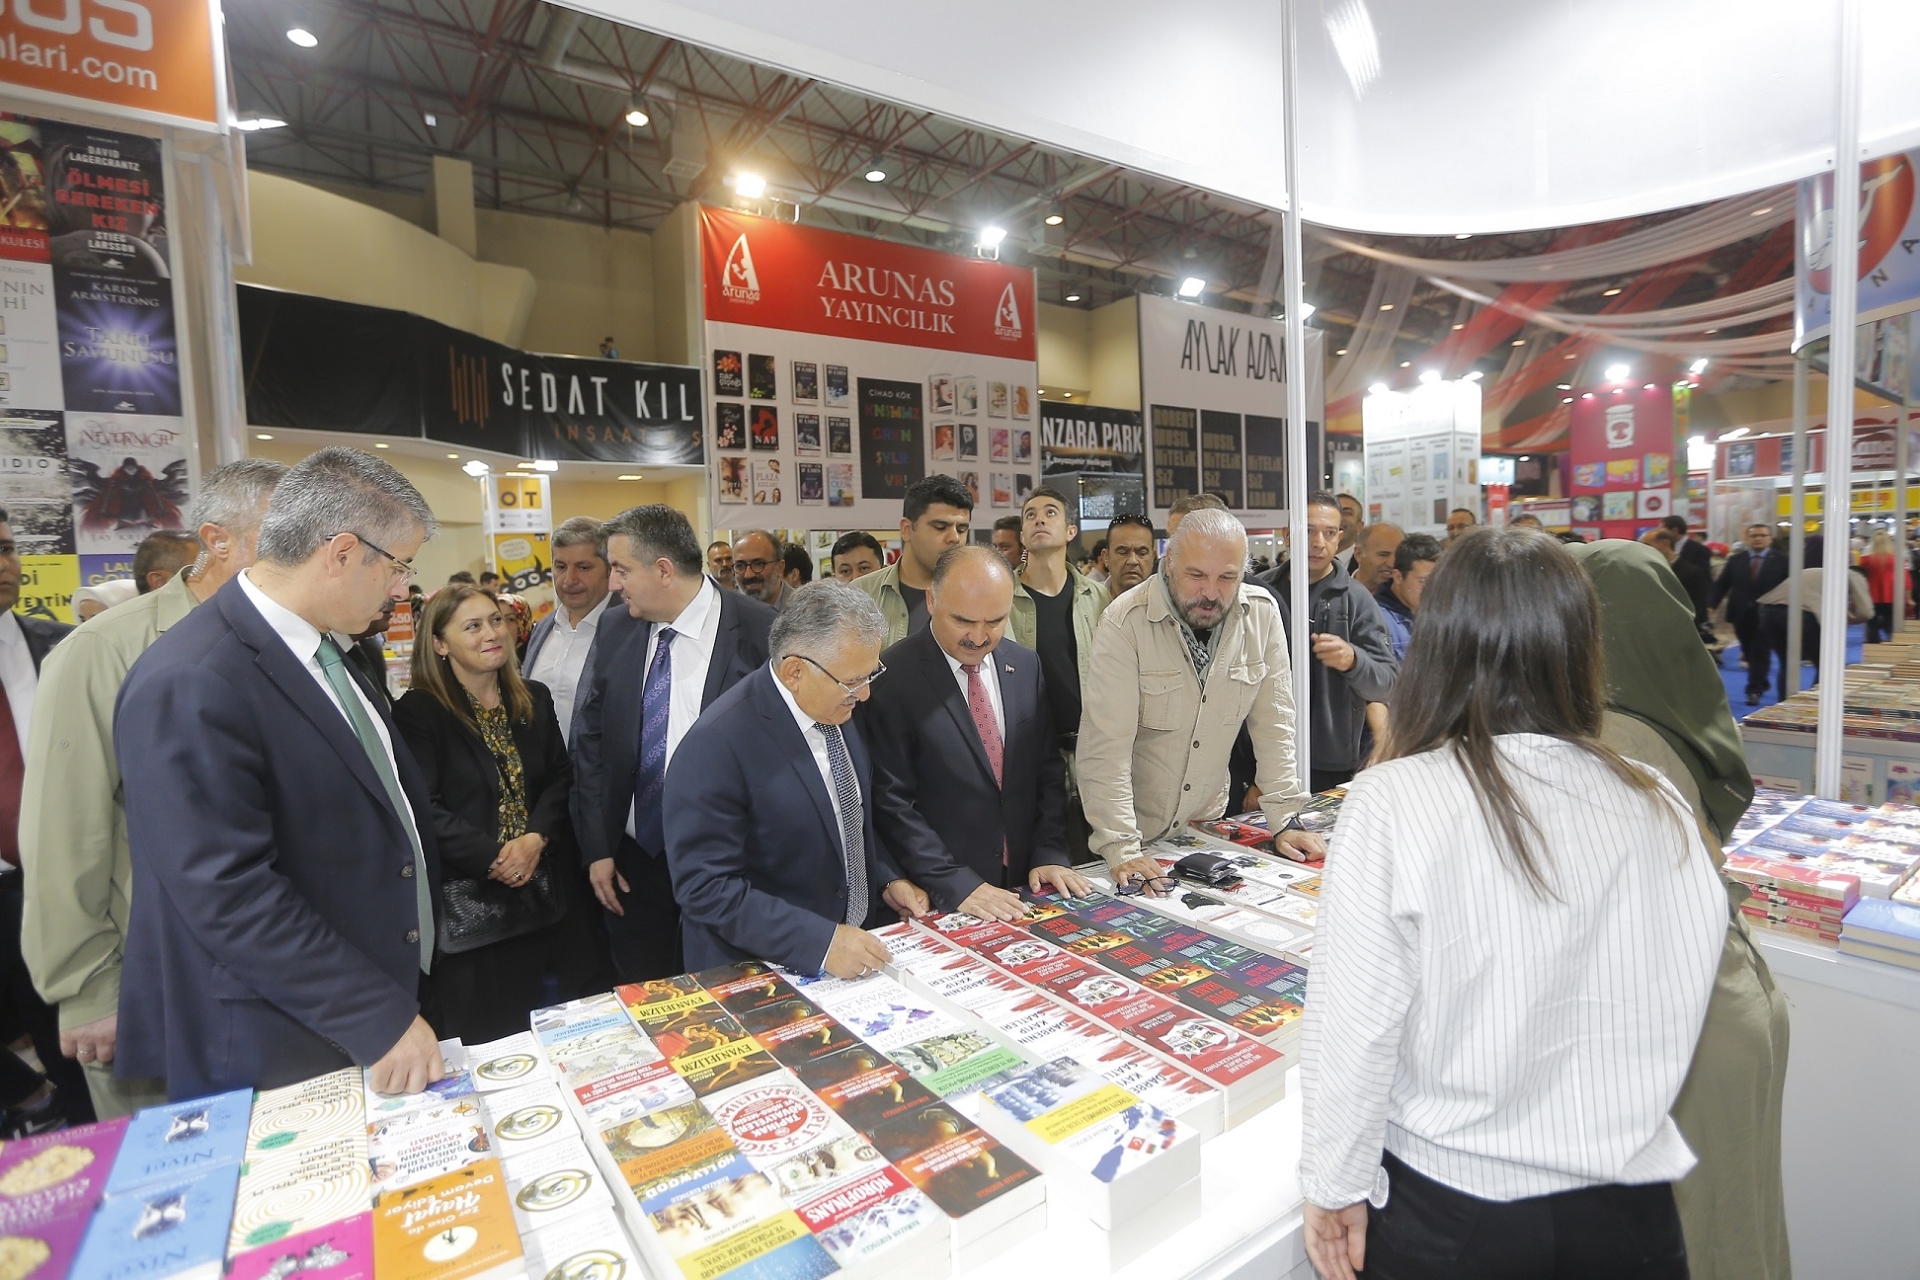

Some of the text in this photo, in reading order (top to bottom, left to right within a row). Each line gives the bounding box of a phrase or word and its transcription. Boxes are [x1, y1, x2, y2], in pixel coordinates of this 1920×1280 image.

[69, 152, 140, 172] LAGERCRANTZ
[88, 145, 120, 158] DAVID
[67, 168, 150, 196] ÖLMESİ
[55, 189, 158, 217] GEREKEN
[92, 213, 127, 231] KIZ
[1, 235, 45, 249] KULESİ
[88, 240, 135, 253] LARSSON
[95, 231, 127, 243] STIEG
[92, 282, 138, 294] KAREN
[817, 259, 955, 308] ARUNAS
[71, 291, 159, 307] ARMSTRONG
[820, 295, 955, 335] YAYINCILIK
[64, 341, 173, 365] SAVUNUSU
[501, 362, 694, 421] SEDAT KIL
[868, 389, 912, 399] CİHAD KÖK
[755, 436, 777, 445] NAR
[1040, 416, 1142, 454] NZARA PARK
[501, 491, 537, 506] OT
[21, 570, 39, 586] Dİ
[886, 937, 906, 952] KAYI
[942, 978, 990, 998] DARBENİN
[944, 976, 972, 989] KAYIP
[639, 996, 704, 1017] EVANJELİZM
[999, 1011, 1046, 1032] SAATLERİ
[1019, 1019, 1048, 1034] KAYIP
[1017, 1020, 1069, 1045] DARBENİN
[680, 1043, 752, 1073] EVANJELİZM
[1116, 1072, 1143, 1087] KAYI
[1128, 1074, 1166, 1095] DARBE
[750, 1113, 802, 1138] TAPINAK
[410, 1131, 448, 1146] SANATI
[400, 1140, 460, 1162] OKUMANIN
[407, 1154, 457, 1175] DOĞANIN
[644, 1154, 736, 1199] HOLLYWOOD
[384, 1174, 494, 1216] Devam Ediyor
[806, 1175, 894, 1224] NÖROFİNANS
[401, 1190, 481, 1229] Hayat
[408, 1205, 479, 1235] Zor Olsa da
